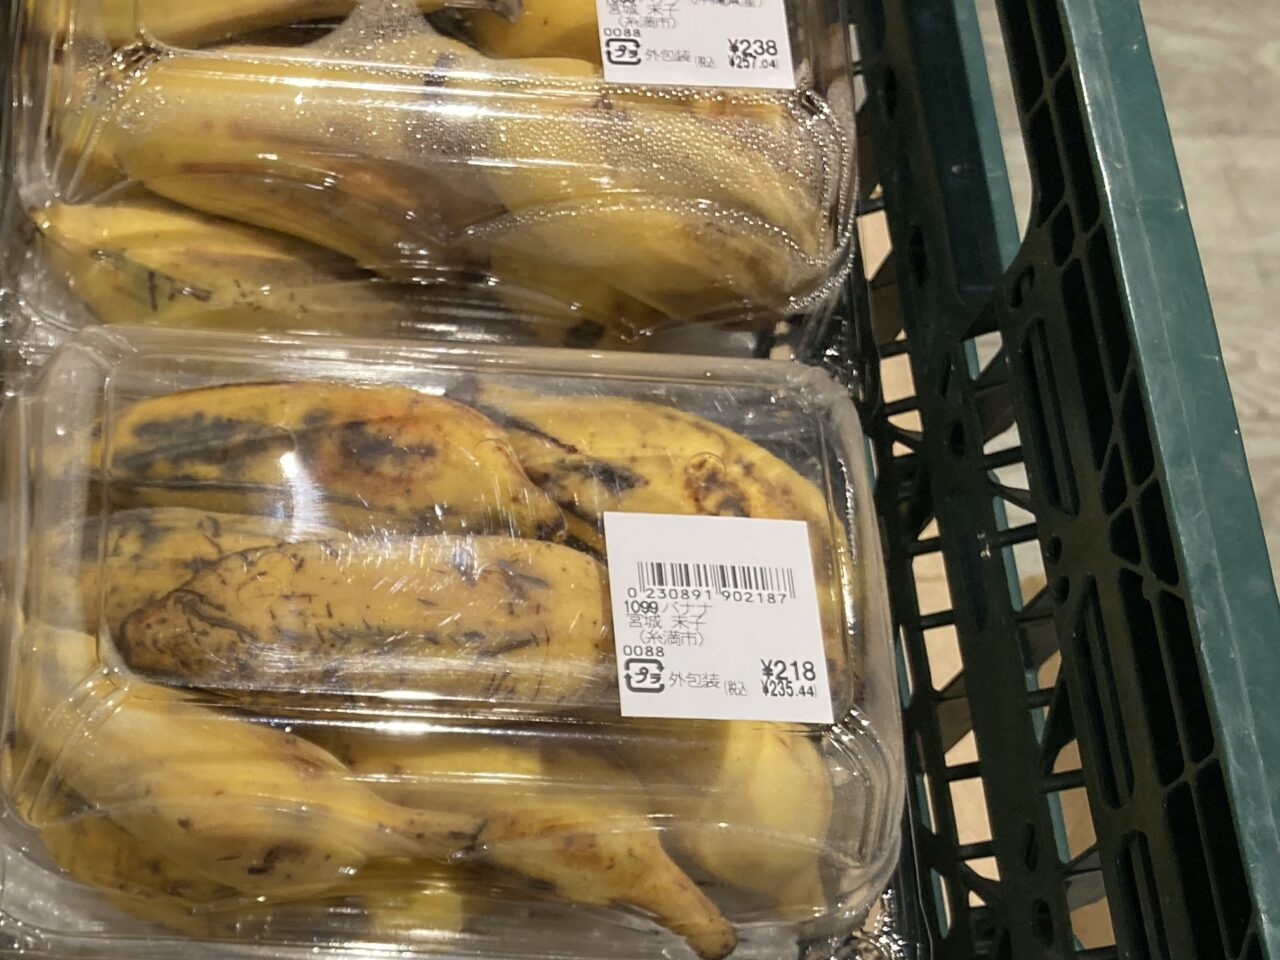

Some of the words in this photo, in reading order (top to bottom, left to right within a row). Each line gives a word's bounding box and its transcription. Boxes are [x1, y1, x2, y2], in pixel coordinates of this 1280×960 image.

[604, 28, 640, 37] 0088
[728, 39, 777, 56] ¥238
[645, 50, 692, 62] 外包装
[628, 588, 637, 598] 0
[646, 588, 712, 600] 230891
[722, 591, 786, 604] 902187
[625, 601, 658, 613] 1099
[662, 603, 712, 614] バナナ
[627, 614, 662, 629] 宮城
[623, 646, 664, 657] 0088
[760, 659, 816, 681] ¥218
[669, 672, 720, 688] 外包装
